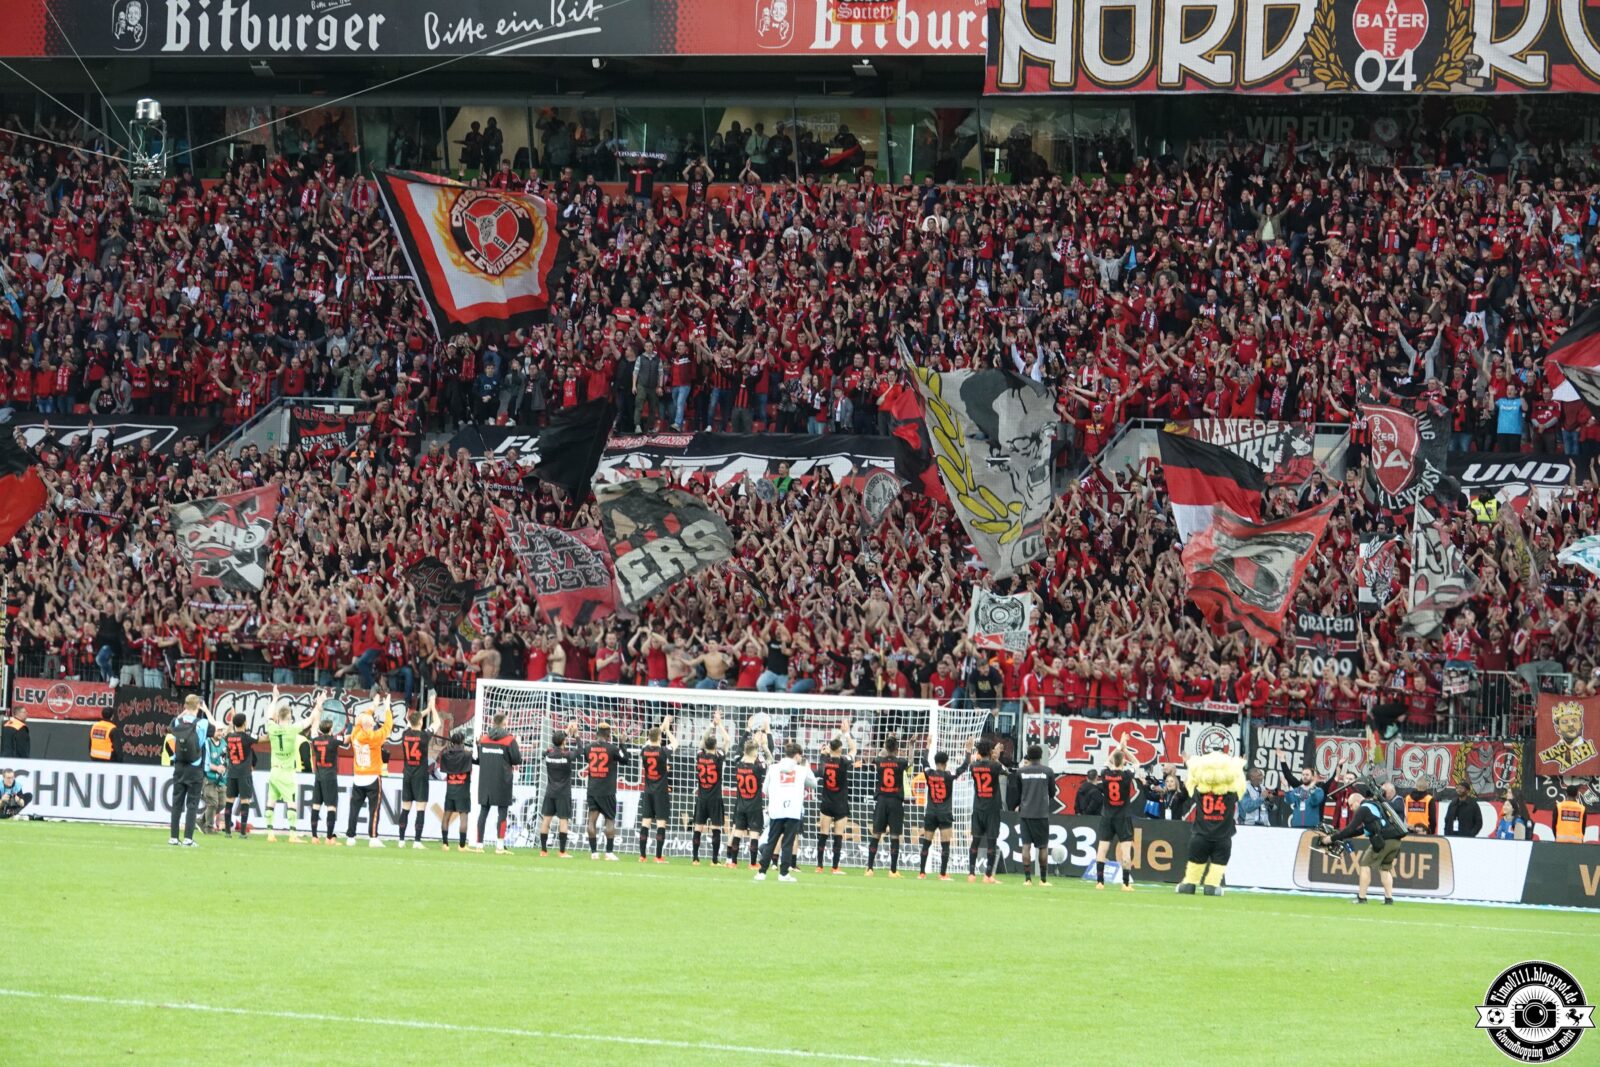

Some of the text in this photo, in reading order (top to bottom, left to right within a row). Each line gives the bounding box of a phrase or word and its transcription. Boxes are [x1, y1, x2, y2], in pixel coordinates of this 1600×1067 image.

[838, 4, 894, 20] Society
[1356, 13, 1425, 28] BAYER
[161, 0, 386, 51] Bitburger
[424, 12, 487, 50] Bitte
[496, 12, 543, 35] ein
[1354, 49, 1417, 92] 04
[1246, 111, 1355, 143] WIR FÜR
[1462, 461, 1571, 483] UND
[15, 687, 47, 704] LEV
[75, 691, 114, 707] addi
[1206, 702, 1238, 712] 2006
[277, 734, 284, 751] 1
[1066, 719, 1187, 766] FSI
[1257, 727, 1308, 752] WEST
[228, 742, 245, 761] 21
[404, 741, 422, 762] 14
[1253, 747, 1306, 772] SIDE
[1540, 744, 1567, 761] KING
[1556, 740, 1596, 771] XABI
[588, 753, 609, 772] 22
[647, 758, 658, 776] 2
[696, 764, 718, 784] 25
[825, 769, 837, 789] 3
[883, 768, 895, 788] 6
[973, 772, 993, 793] 12
[736, 774, 758, 796] 20
[930, 780, 947, 802] 19
[1108, 781, 1121, 801] 8
[1202, 795, 1227, 815] 04
